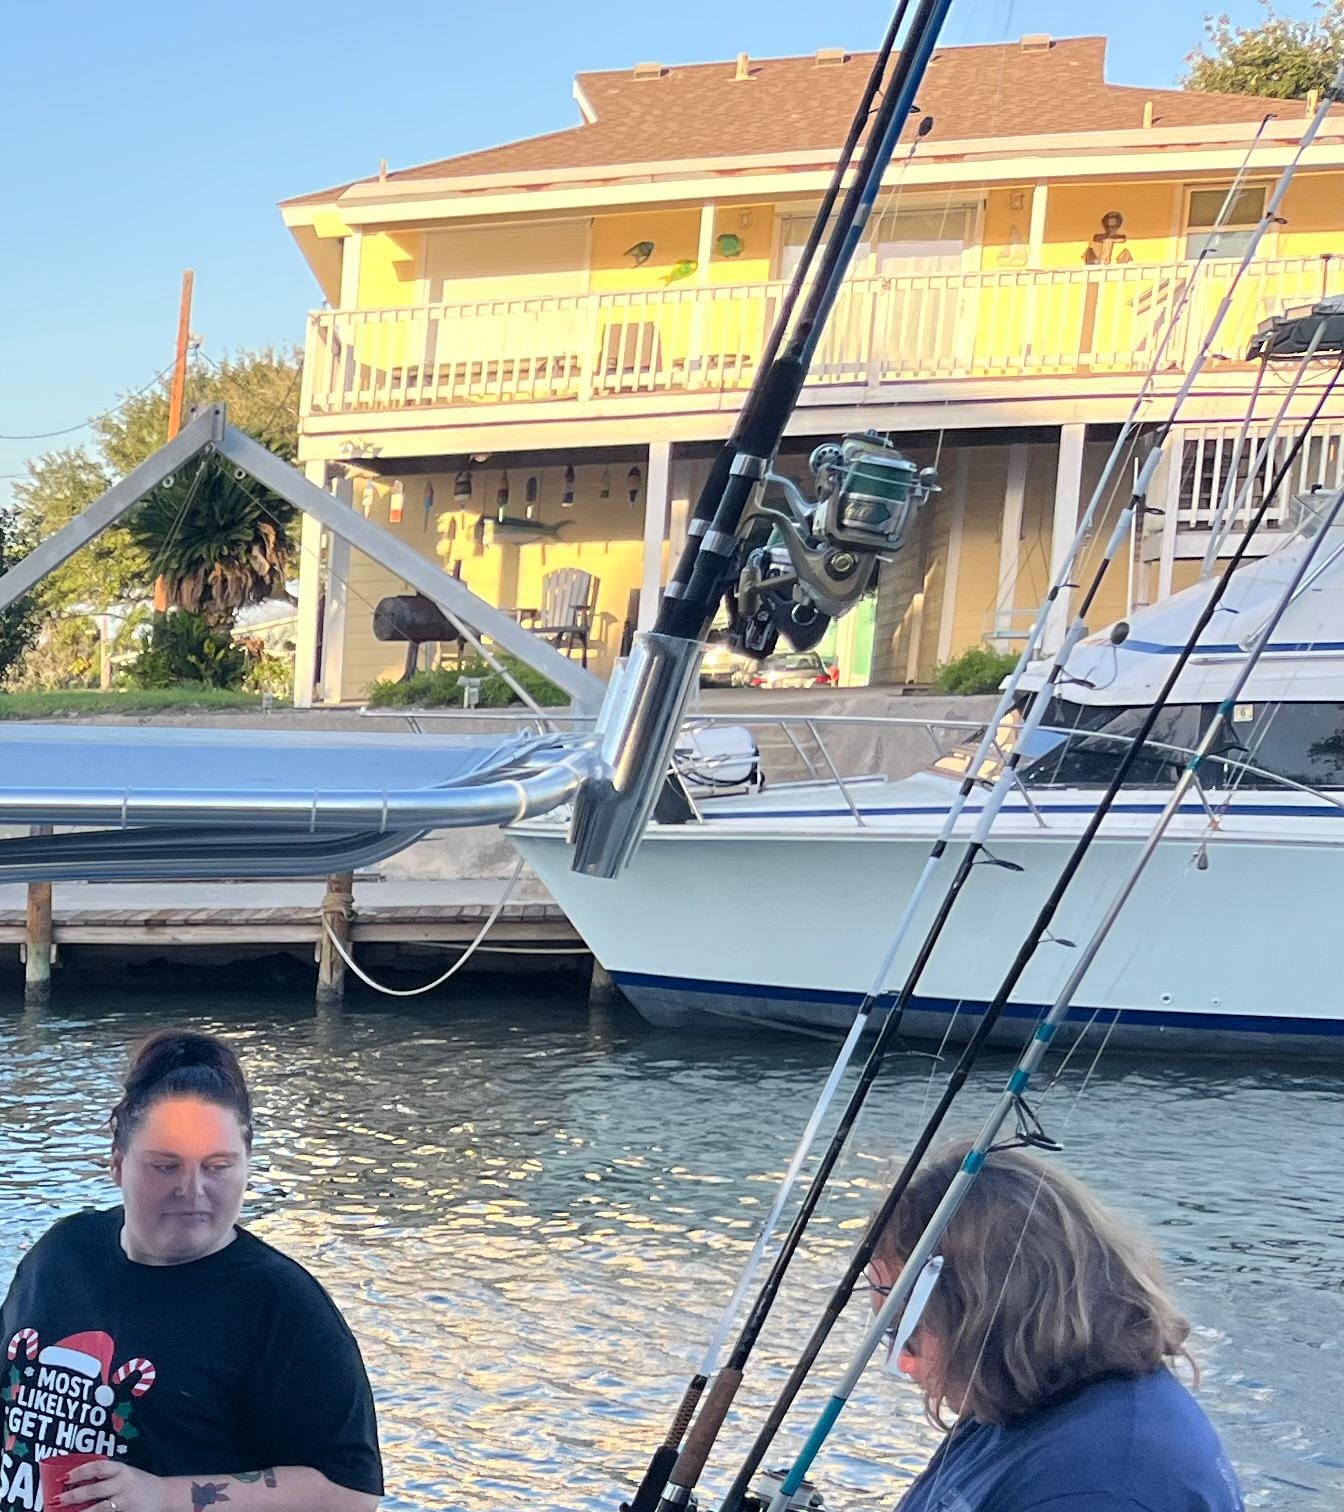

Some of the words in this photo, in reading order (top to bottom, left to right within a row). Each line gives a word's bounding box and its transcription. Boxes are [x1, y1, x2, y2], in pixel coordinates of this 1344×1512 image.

[37, 1367, 94, 1400] MOST
[17, 1385, 80, 1420] LIKELY
[79, 1403, 107, 1427] TO
[8, 1407, 53, 1441] GET
[55, 1421, 116, 1457] HIGH
